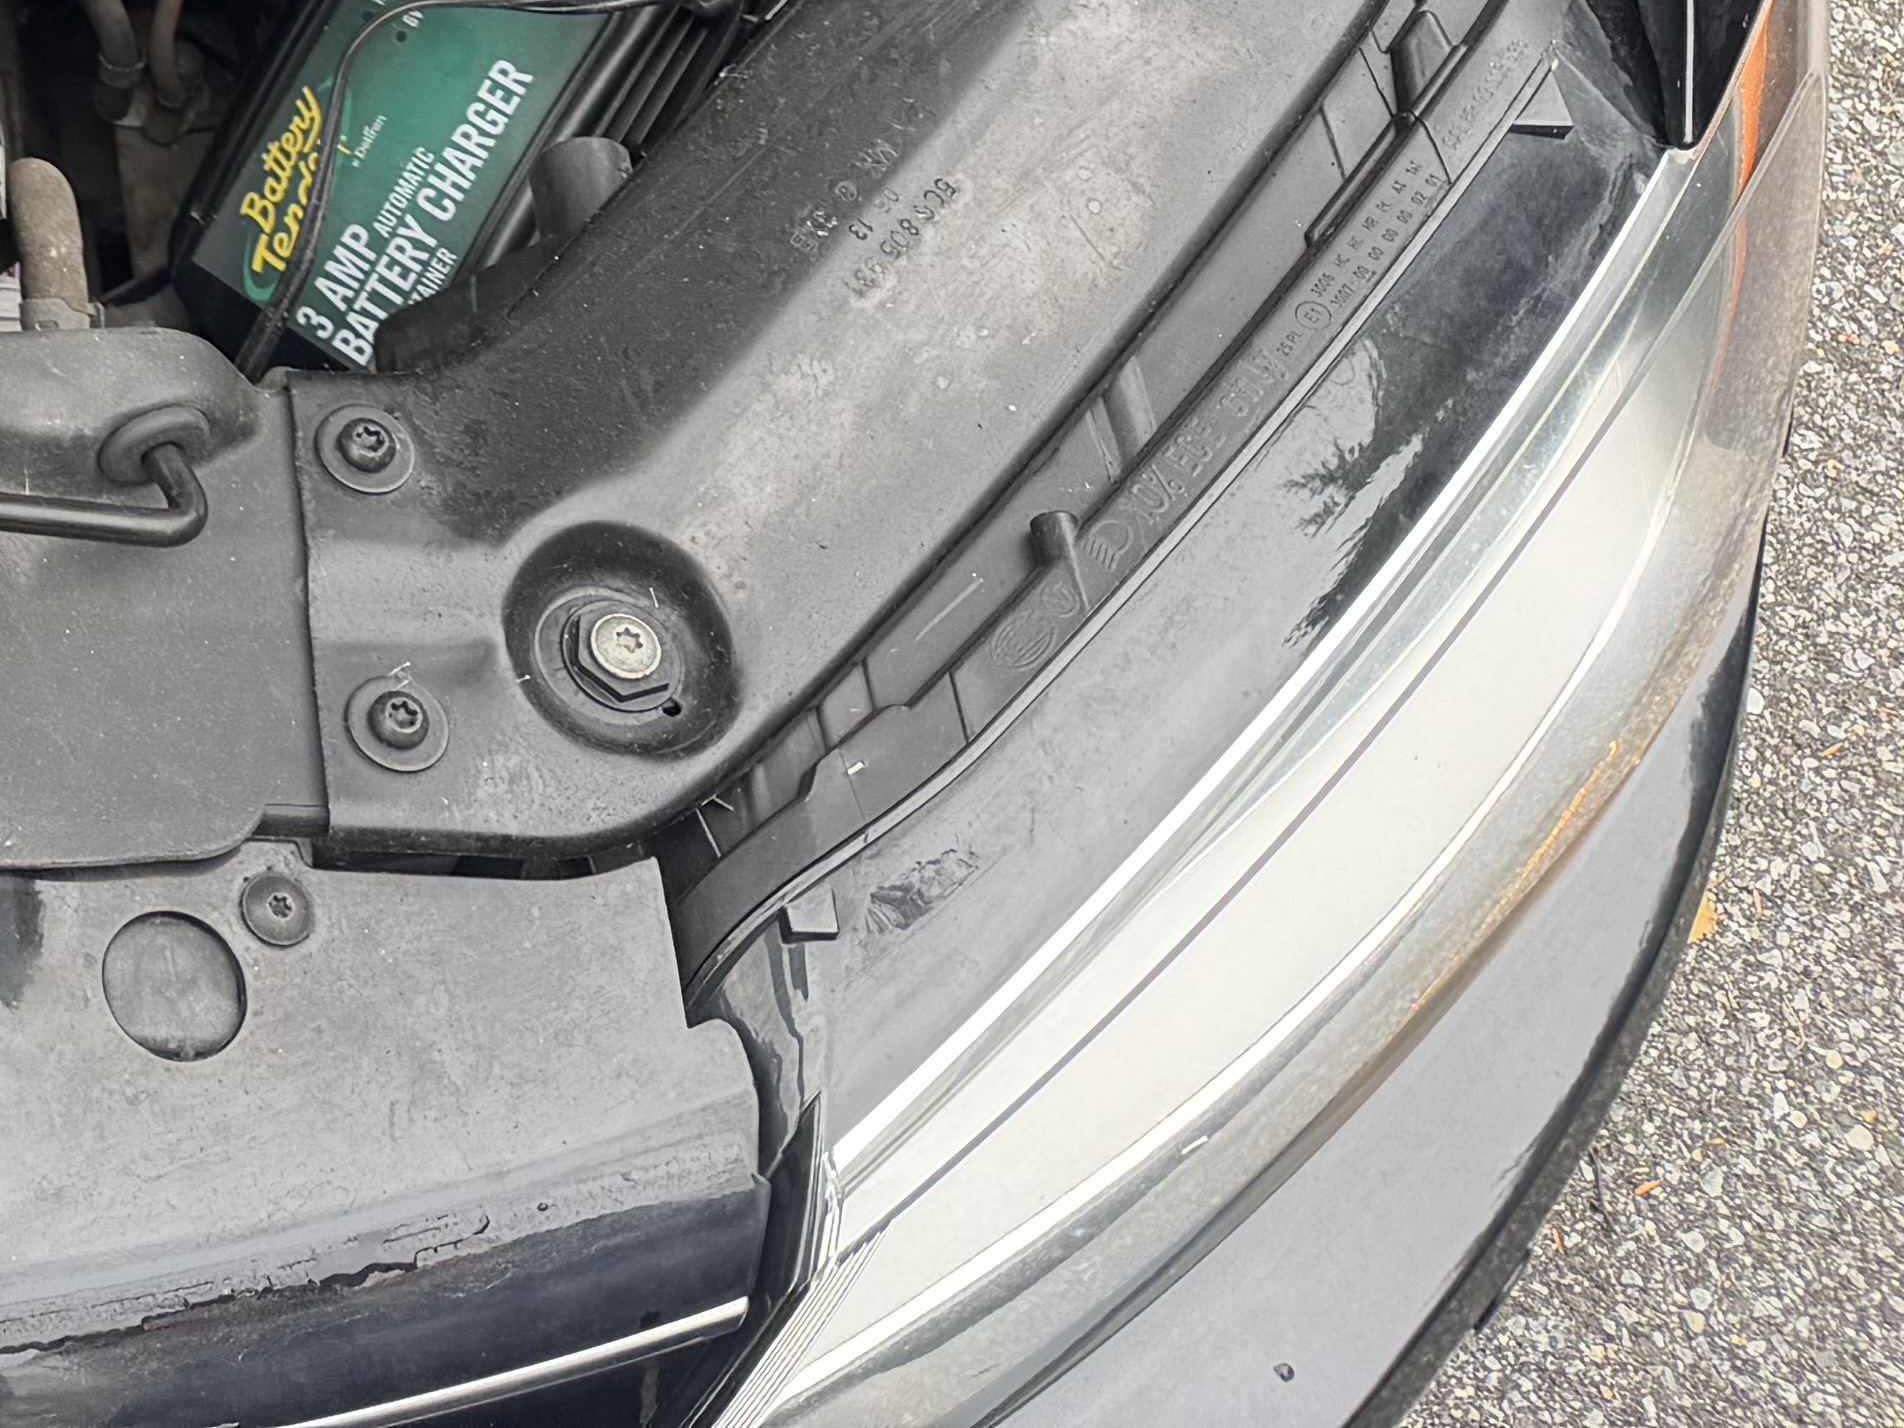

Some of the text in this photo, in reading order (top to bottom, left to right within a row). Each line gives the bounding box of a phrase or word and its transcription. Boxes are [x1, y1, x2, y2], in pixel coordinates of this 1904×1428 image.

[240, 85, 323, 234] Battery
[372, 146, 435, 239] AUTOMATIC
[331, 59, 535, 368] BATTERY CHARGER
[848, 218, 873, 241] 13
[1352, 262, 1371, 282] 00
[1367, 244, 1385, 263] 00
[1382, 226, 1399, 245] 00
[1410, 189, 1427, 207] 02
[295, 223, 378, 340] 3 AMP
[407, 246, 459, 306] TAINER
[1164, 418, 1220, 477] ECE
